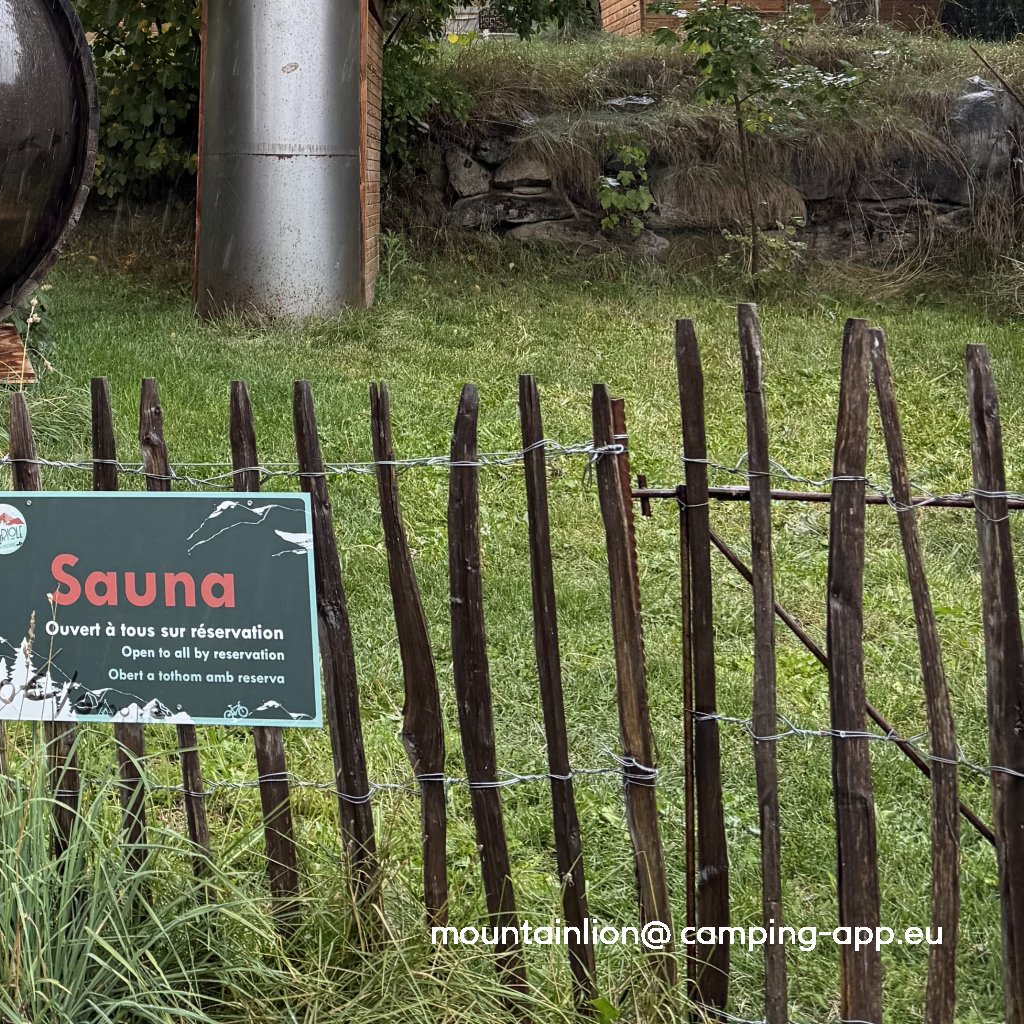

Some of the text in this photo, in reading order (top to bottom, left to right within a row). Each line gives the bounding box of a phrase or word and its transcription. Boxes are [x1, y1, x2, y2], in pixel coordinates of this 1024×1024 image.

[51, 553, 236, 608] Sauna
[45, 620, 284, 640] Ouvert à tous sur réservation
[121, 645, 285, 662] Open to all by reservation
[108, 668, 285, 684] Obert a tothom amb reserva
